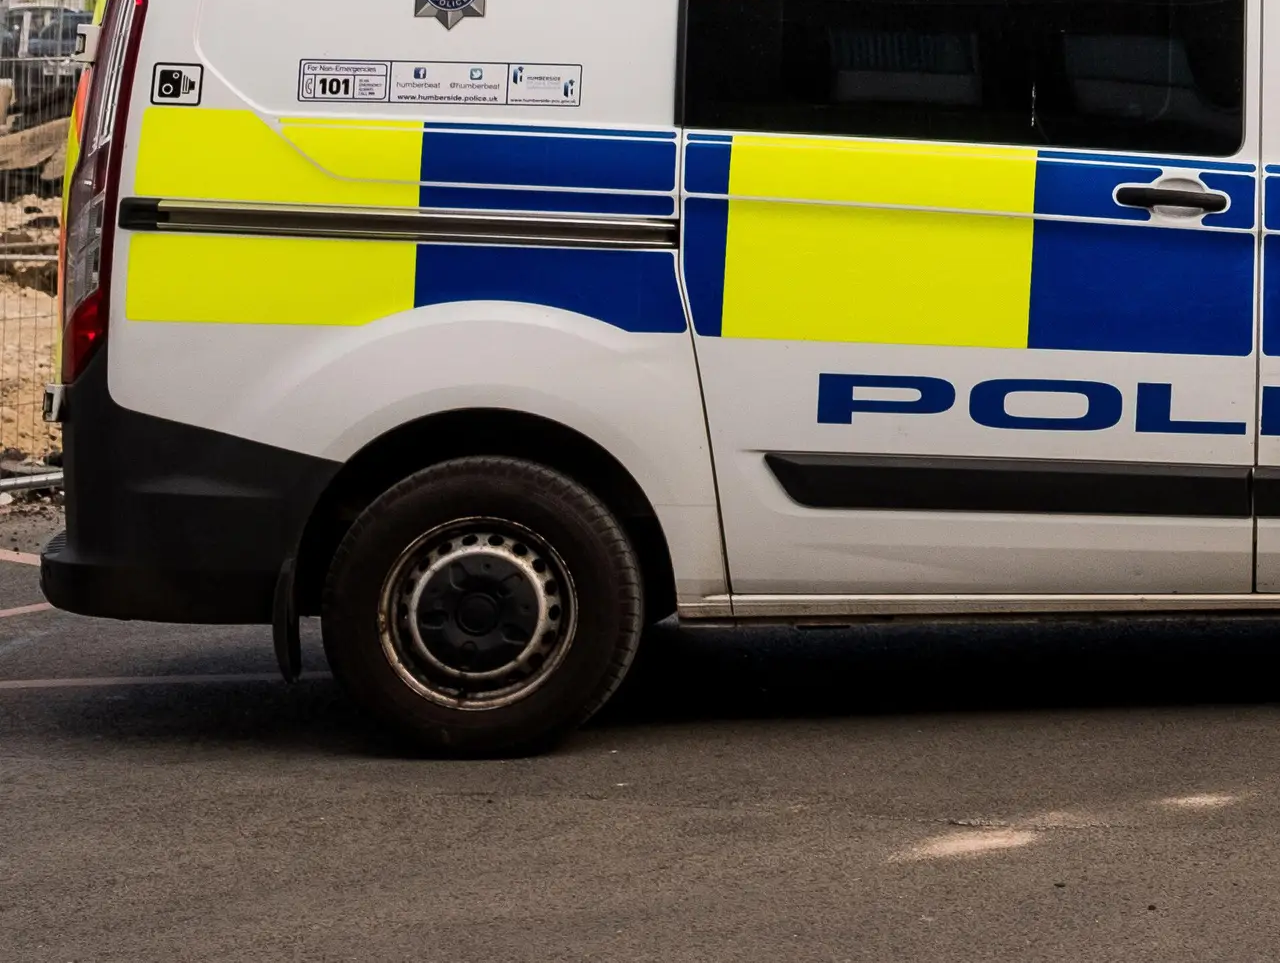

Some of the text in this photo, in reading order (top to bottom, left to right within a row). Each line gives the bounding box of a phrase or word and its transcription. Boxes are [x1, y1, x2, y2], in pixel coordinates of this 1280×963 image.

[307, 64, 317, 72] For
[319, 78, 350, 95] 101
[396, 81, 441, 89] humberbeat
[450, 82, 500, 90] @humberbeat
[397, 94, 498, 102] www.humberside.police.uk
